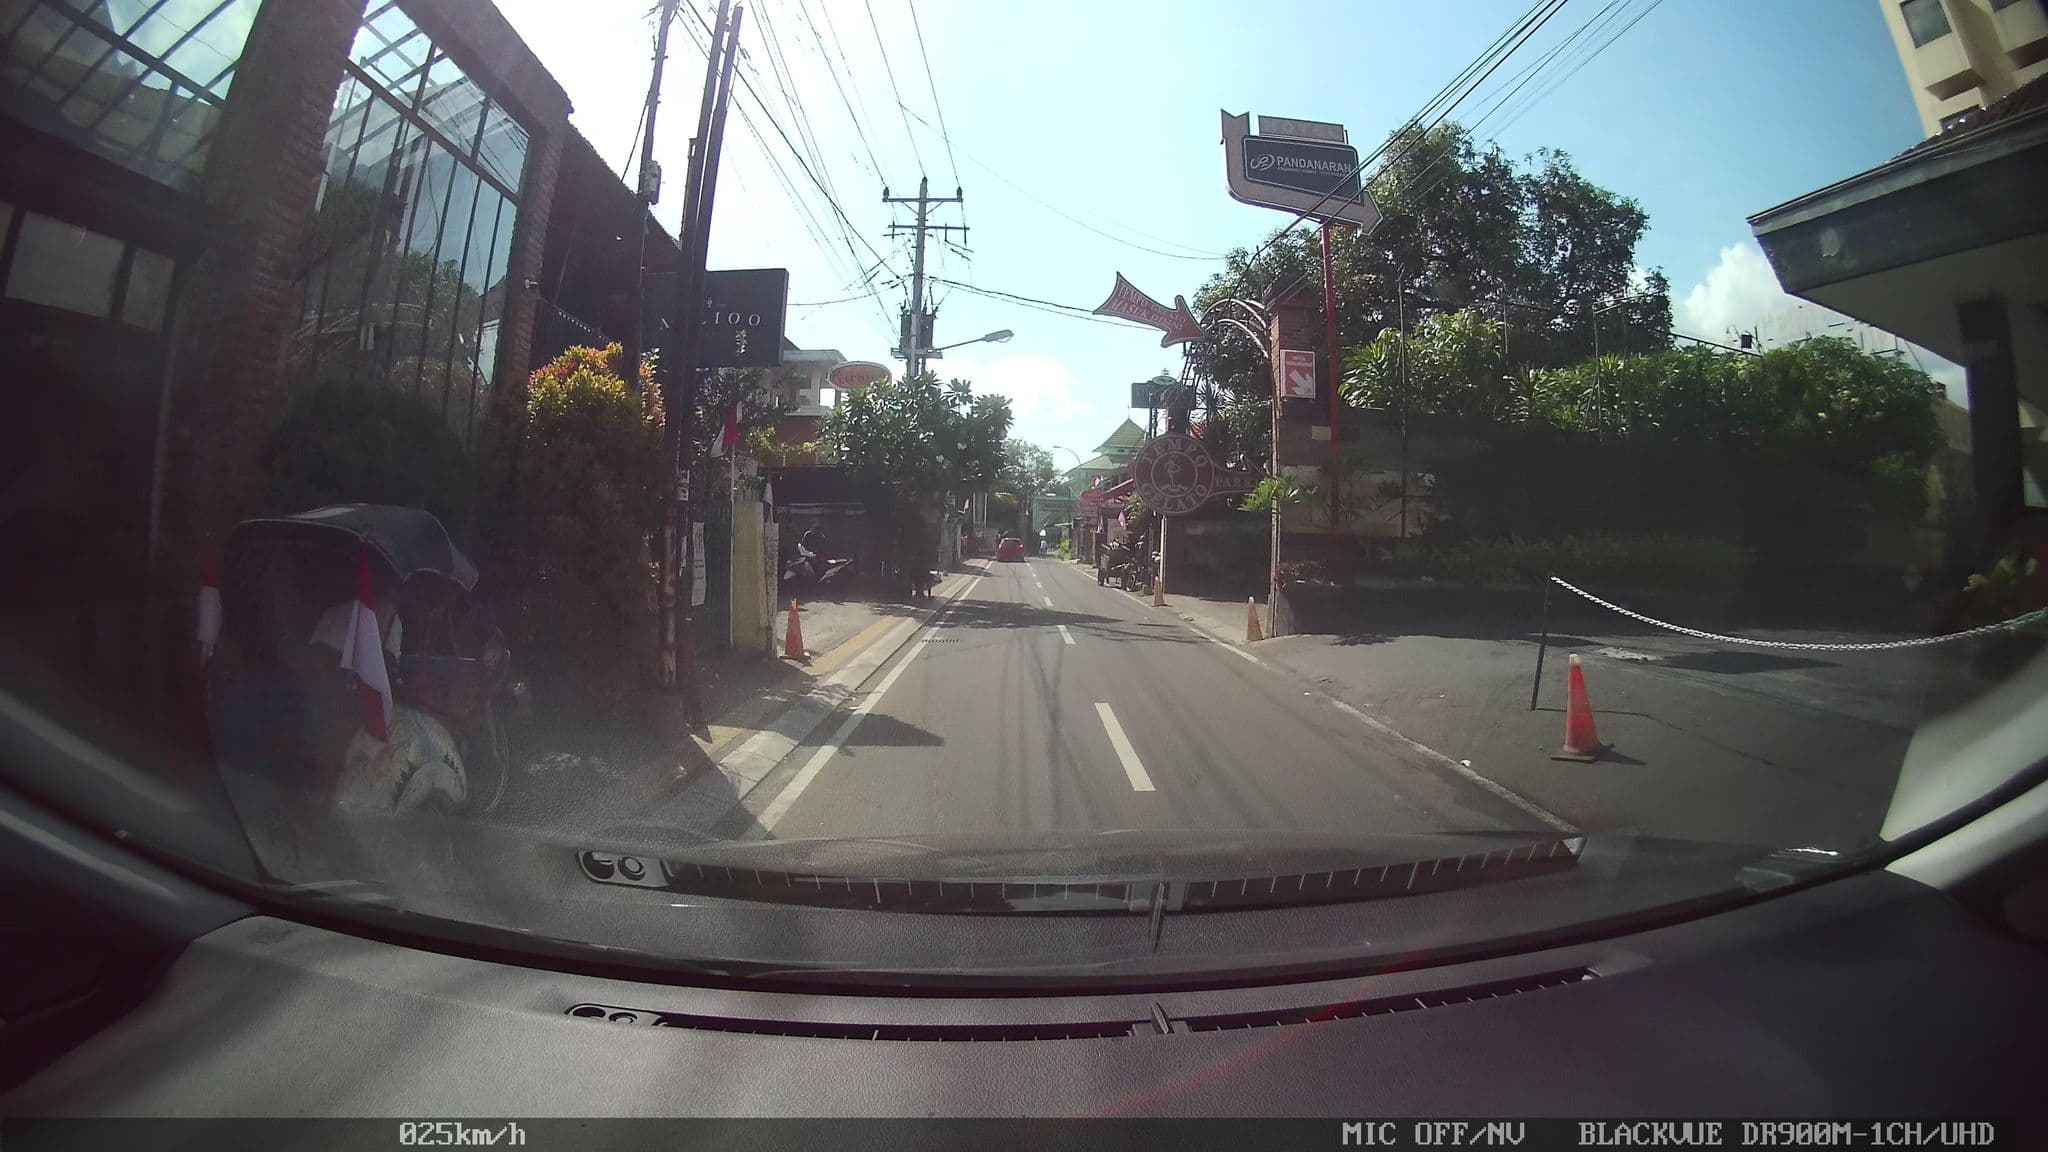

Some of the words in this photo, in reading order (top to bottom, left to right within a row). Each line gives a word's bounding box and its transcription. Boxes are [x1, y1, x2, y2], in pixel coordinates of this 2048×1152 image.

[1277, 156, 1351, 173] PANDANARAN
[1142, 438, 1208, 466] TEMPO
[1141, 484, 1207, 511] GELATO
